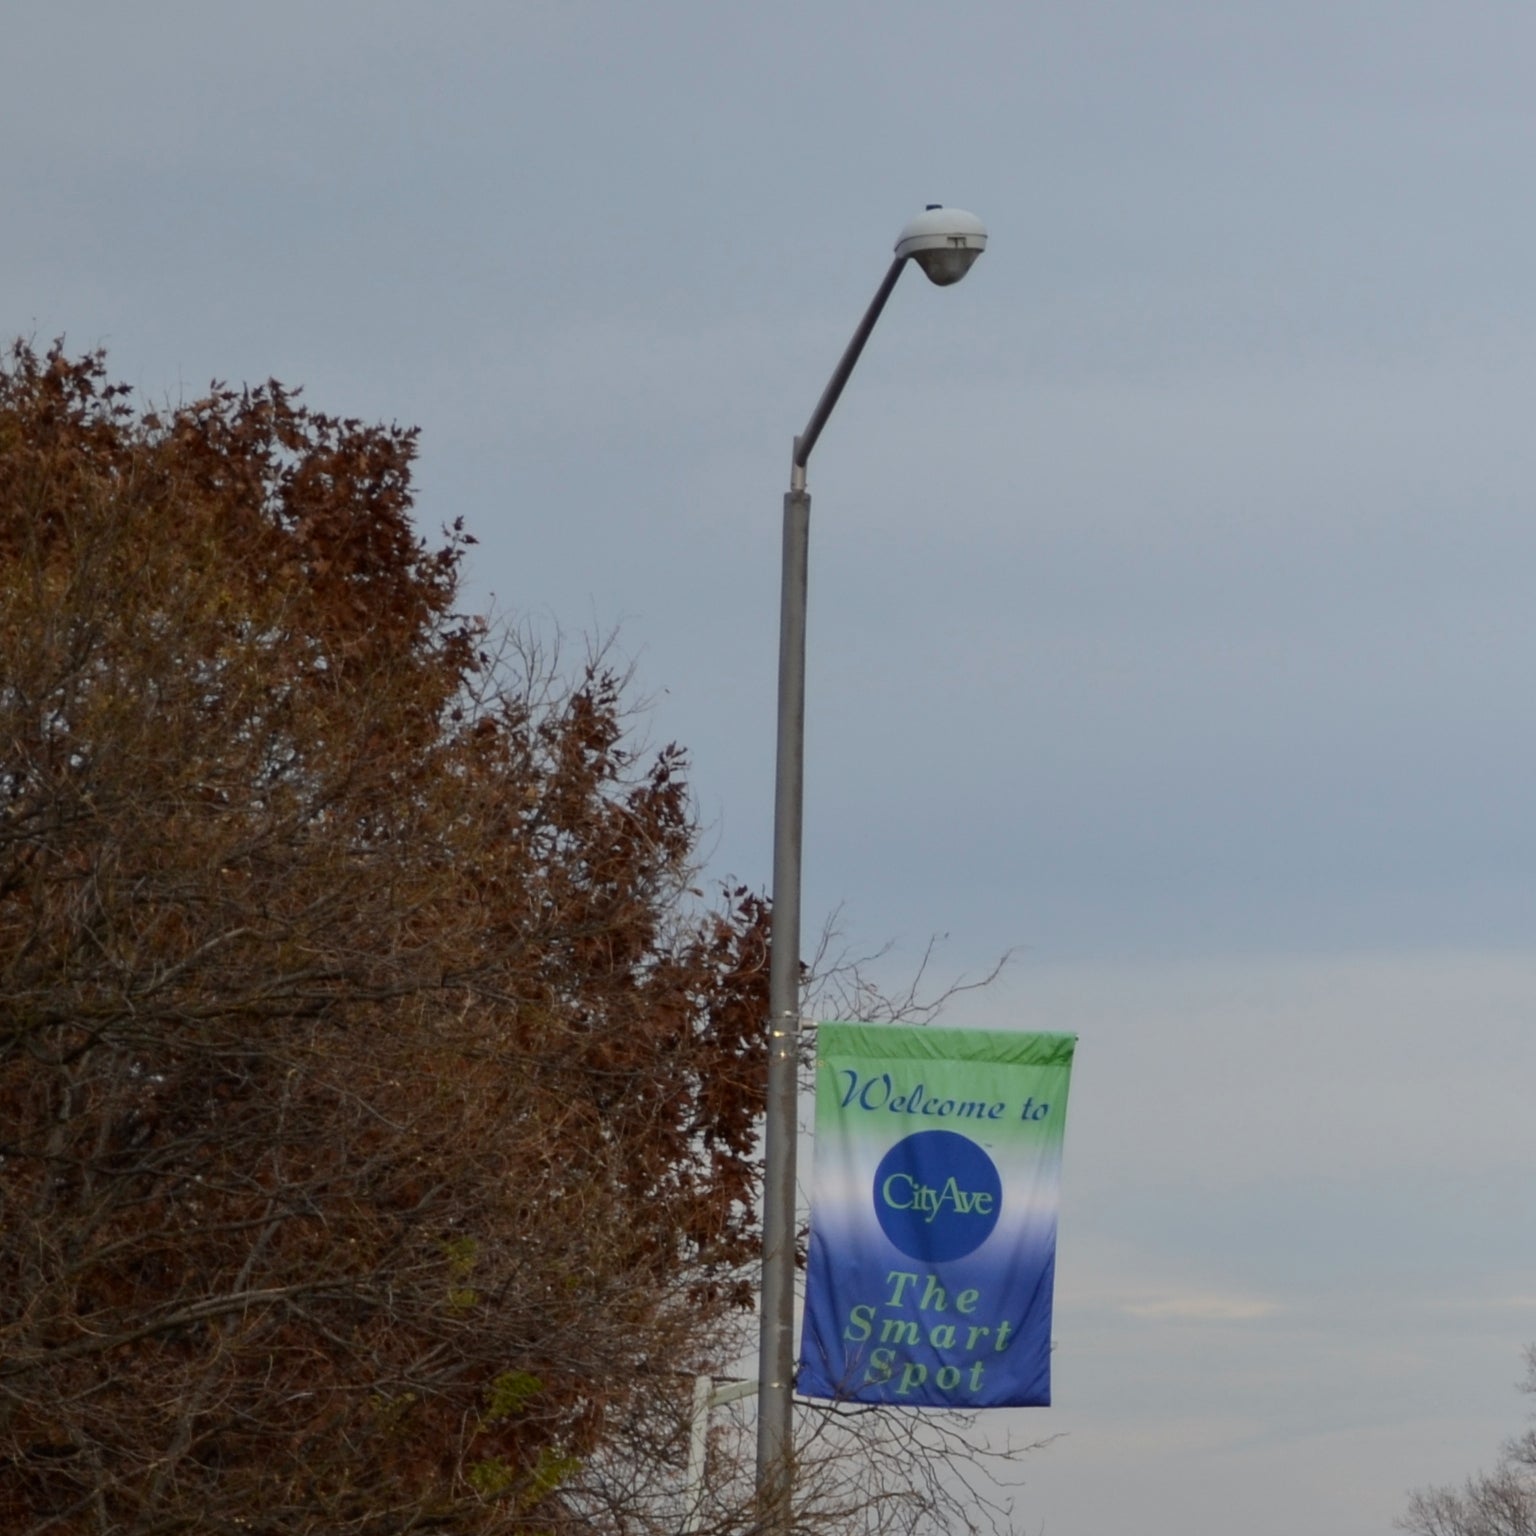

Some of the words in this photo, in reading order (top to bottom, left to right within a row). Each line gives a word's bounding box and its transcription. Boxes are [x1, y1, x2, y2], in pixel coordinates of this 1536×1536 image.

[838, 1069, 1006, 1121] Welcome
[1020, 1097, 1049, 1122] to
[881, 1173, 993, 1223] CityAve
[885, 1271, 981, 1314] The
[843, 1306, 1013, 1351] Smart
[864, 1348, 985, 1394] Spot
